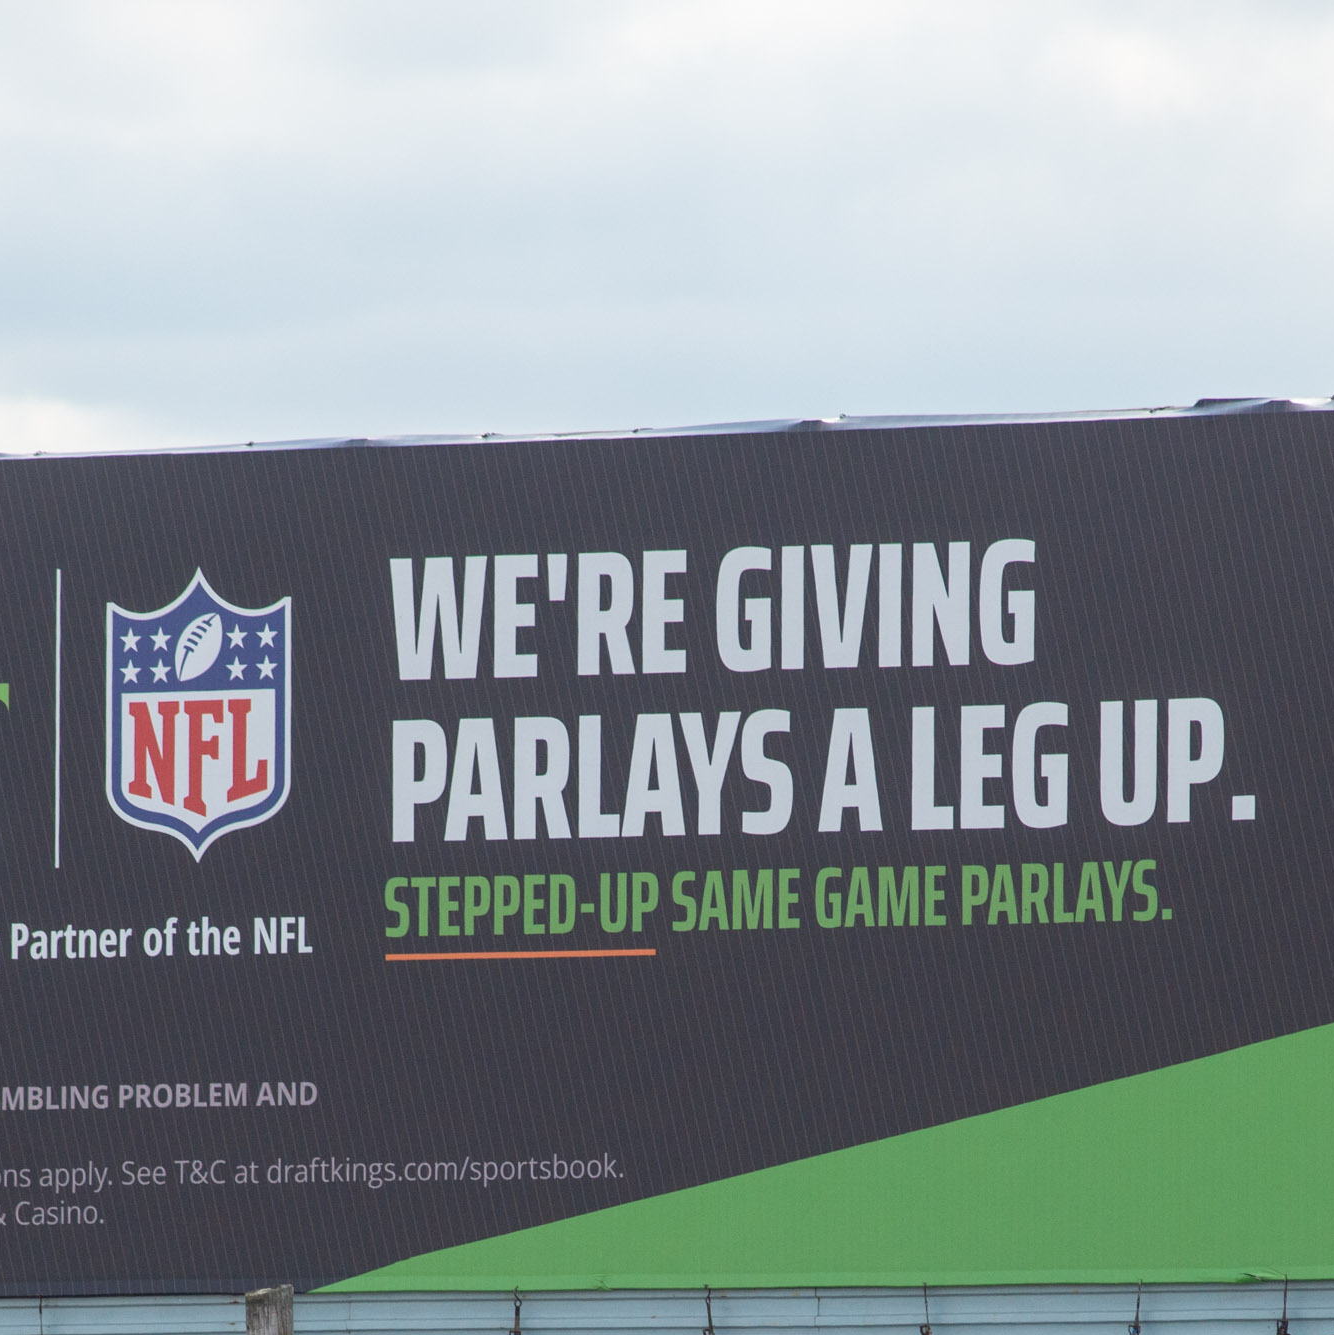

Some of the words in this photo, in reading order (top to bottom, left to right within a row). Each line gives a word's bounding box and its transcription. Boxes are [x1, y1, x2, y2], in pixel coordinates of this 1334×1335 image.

[389, 548, 688, 681] WE'RE
[715, 538, 1037, 674] GIVING
[127, 697, 269, 817] NFL
[391, 708, 794, 843] PARLAYS
[817, 707, 884, 833] A
[910, 701, 1070, 831] LEG
[1099, 697, 1257, 827] UP.
[384, 870, 660, 939] STEPPED-UP
[671, 867, 802, 933] SAME
[814, 863, 948, 929] GAME
[961, 858, 1175, 926] PARLAYS.
[11, 921, 133, 961] Partner
[143, 916, 179, 958] of
[186, 916, 241, 957] the
[253, 916, 314, 956] NFL
[117, 1082, 248, 1109] PROBLEM
[255, 1081, 319, 1107] AND
[38, 1160, 114, 1195] apply.
[120, 1160, 168, 1186] See
[174, 1159, 227, 1186] T&C
[233, 1161, 260, 1185] at
[266, 1152, 625, 1190] draftkings.com/sportsbook.
[14, 1199, 106, 1227] Casino.
